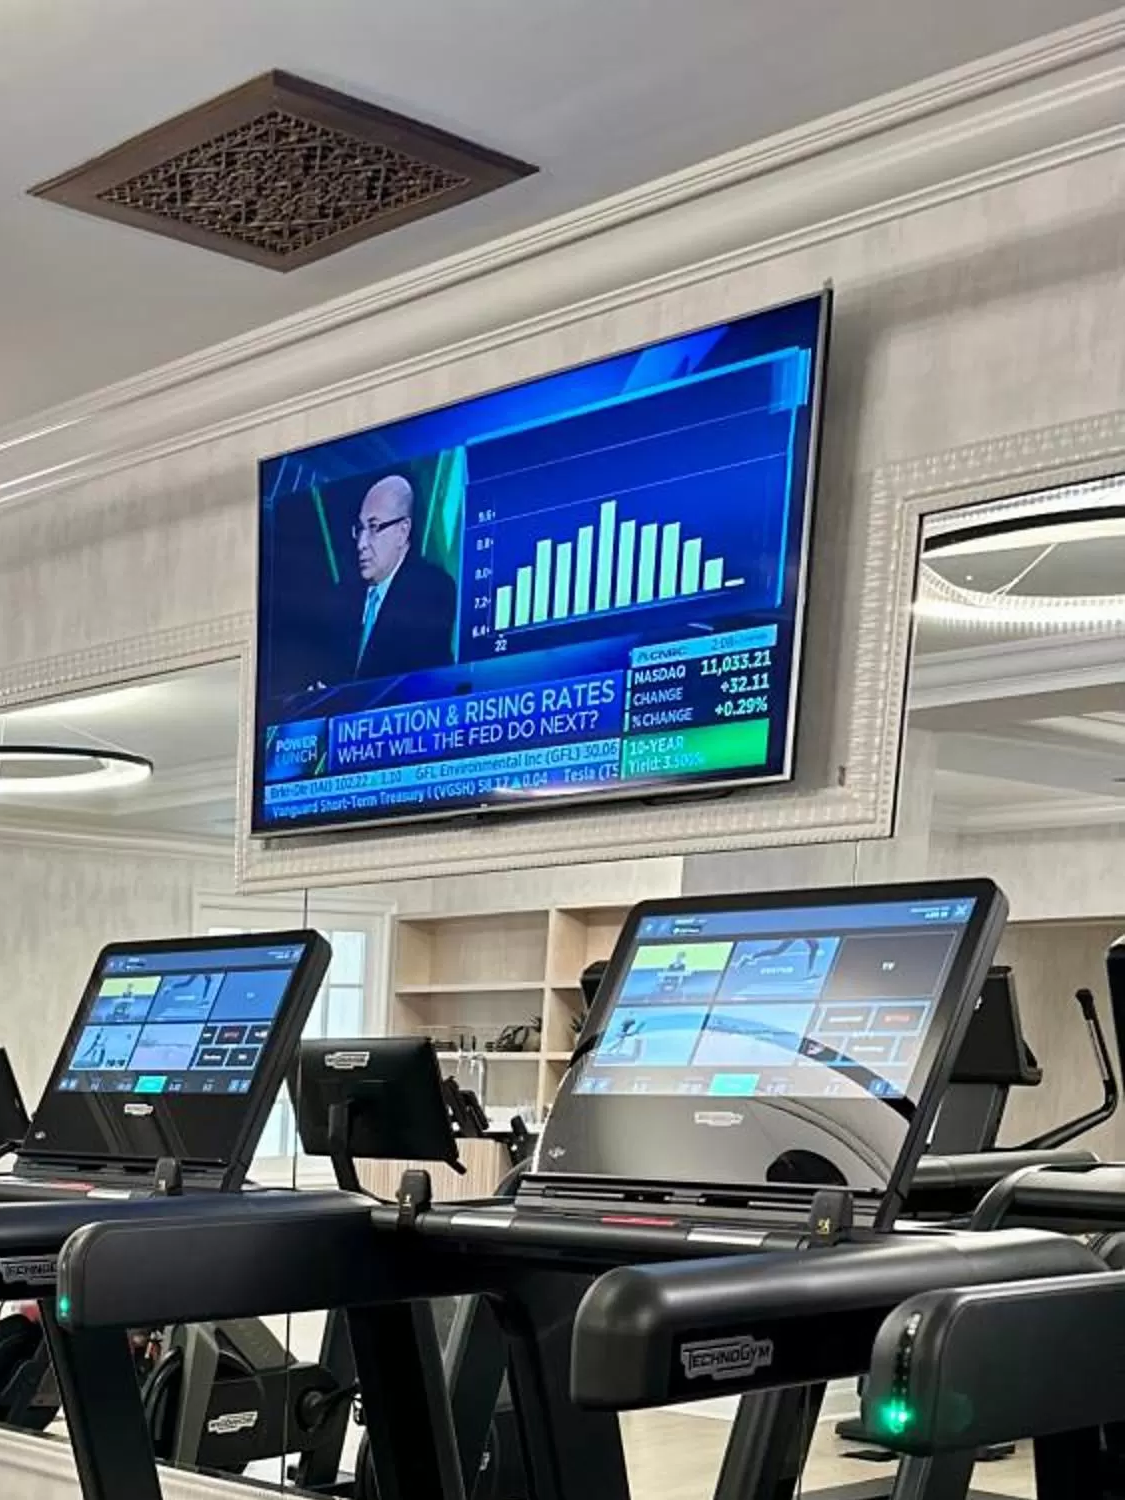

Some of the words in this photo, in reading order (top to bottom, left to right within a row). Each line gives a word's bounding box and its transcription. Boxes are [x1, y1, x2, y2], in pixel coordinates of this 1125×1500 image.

[634, 664, 686, 685] NASDAQ
[700, 649, 772, 677] 11,033.21
[720, 673, 770, 694] +32.11
[632, 687, 684, 706] CHANGE
[714, 695, 768, 717] +0.29%
[338, 706, 441, 743] INFLATION
[446, 703, 460, 726] &
[465, 691, 536, 725] RISING
[541, 679, 616, 713] RATES
[276, 735, 318, 753] POWER
[337, 741, 386, 765] WHAT
[388, 737, 428, 758] WILL
[433, 728, 465, 751] THE
[468, 723, 503, 747] FED
[508, 719, 535, 741] DO
[540, 710, 599, 737] NEXT?
[629, 735, 684, 755] 10-YEAR
[440, 756, 522, 777] Environmental
[525, 752, 543, 767] Inc
[545, 746, 580, 765] (GFL)
[273, 802, 318, 818] Vanguard
[320, 793, 378, 812] Short-Term
[379, 788, 424, 806] Treasury
[434, 782, 475, 801] (VGSH)
[563, 766, 596, 783] Tesla
[680, 1336, 774, 1379] TECHNOGYM
